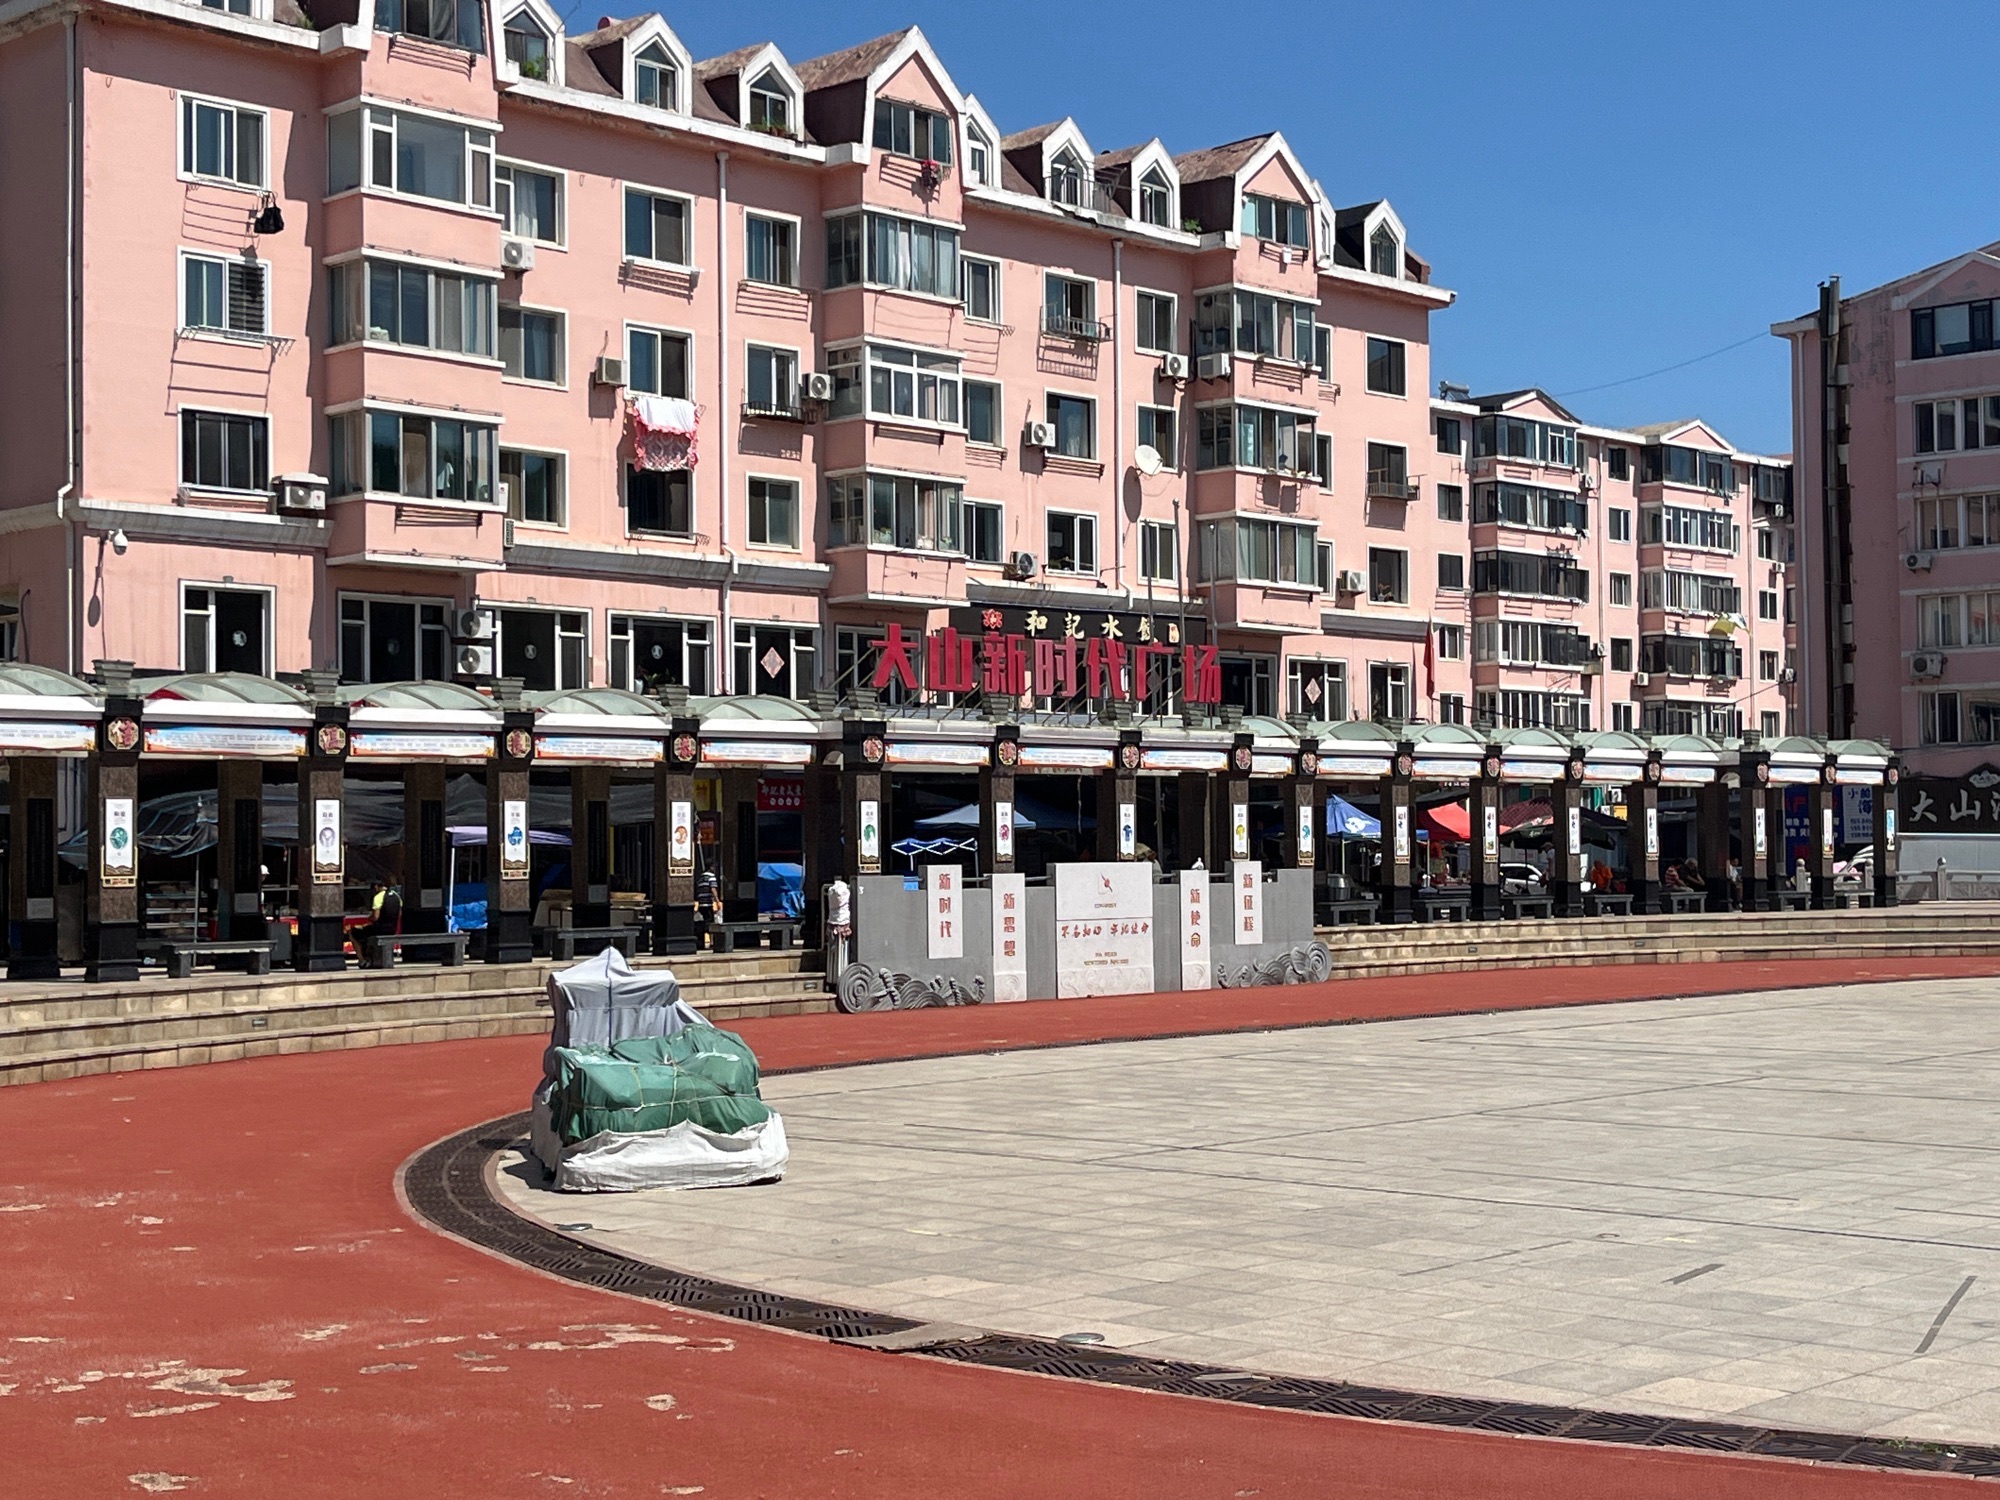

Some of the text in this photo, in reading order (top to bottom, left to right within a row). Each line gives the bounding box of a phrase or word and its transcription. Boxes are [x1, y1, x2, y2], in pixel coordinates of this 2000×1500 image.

[871, 623, 1221, 703] 大山新时代广场
[939, 873, 952, 938] 新时代
[1003, 893, 1016, 957] 新思想
[1061, 922, 1149, 938] 不忘初心 牢记使命
[1190, 888, 1201, 947] 新使命
[1243, 873, 1254, 931] 新征程
